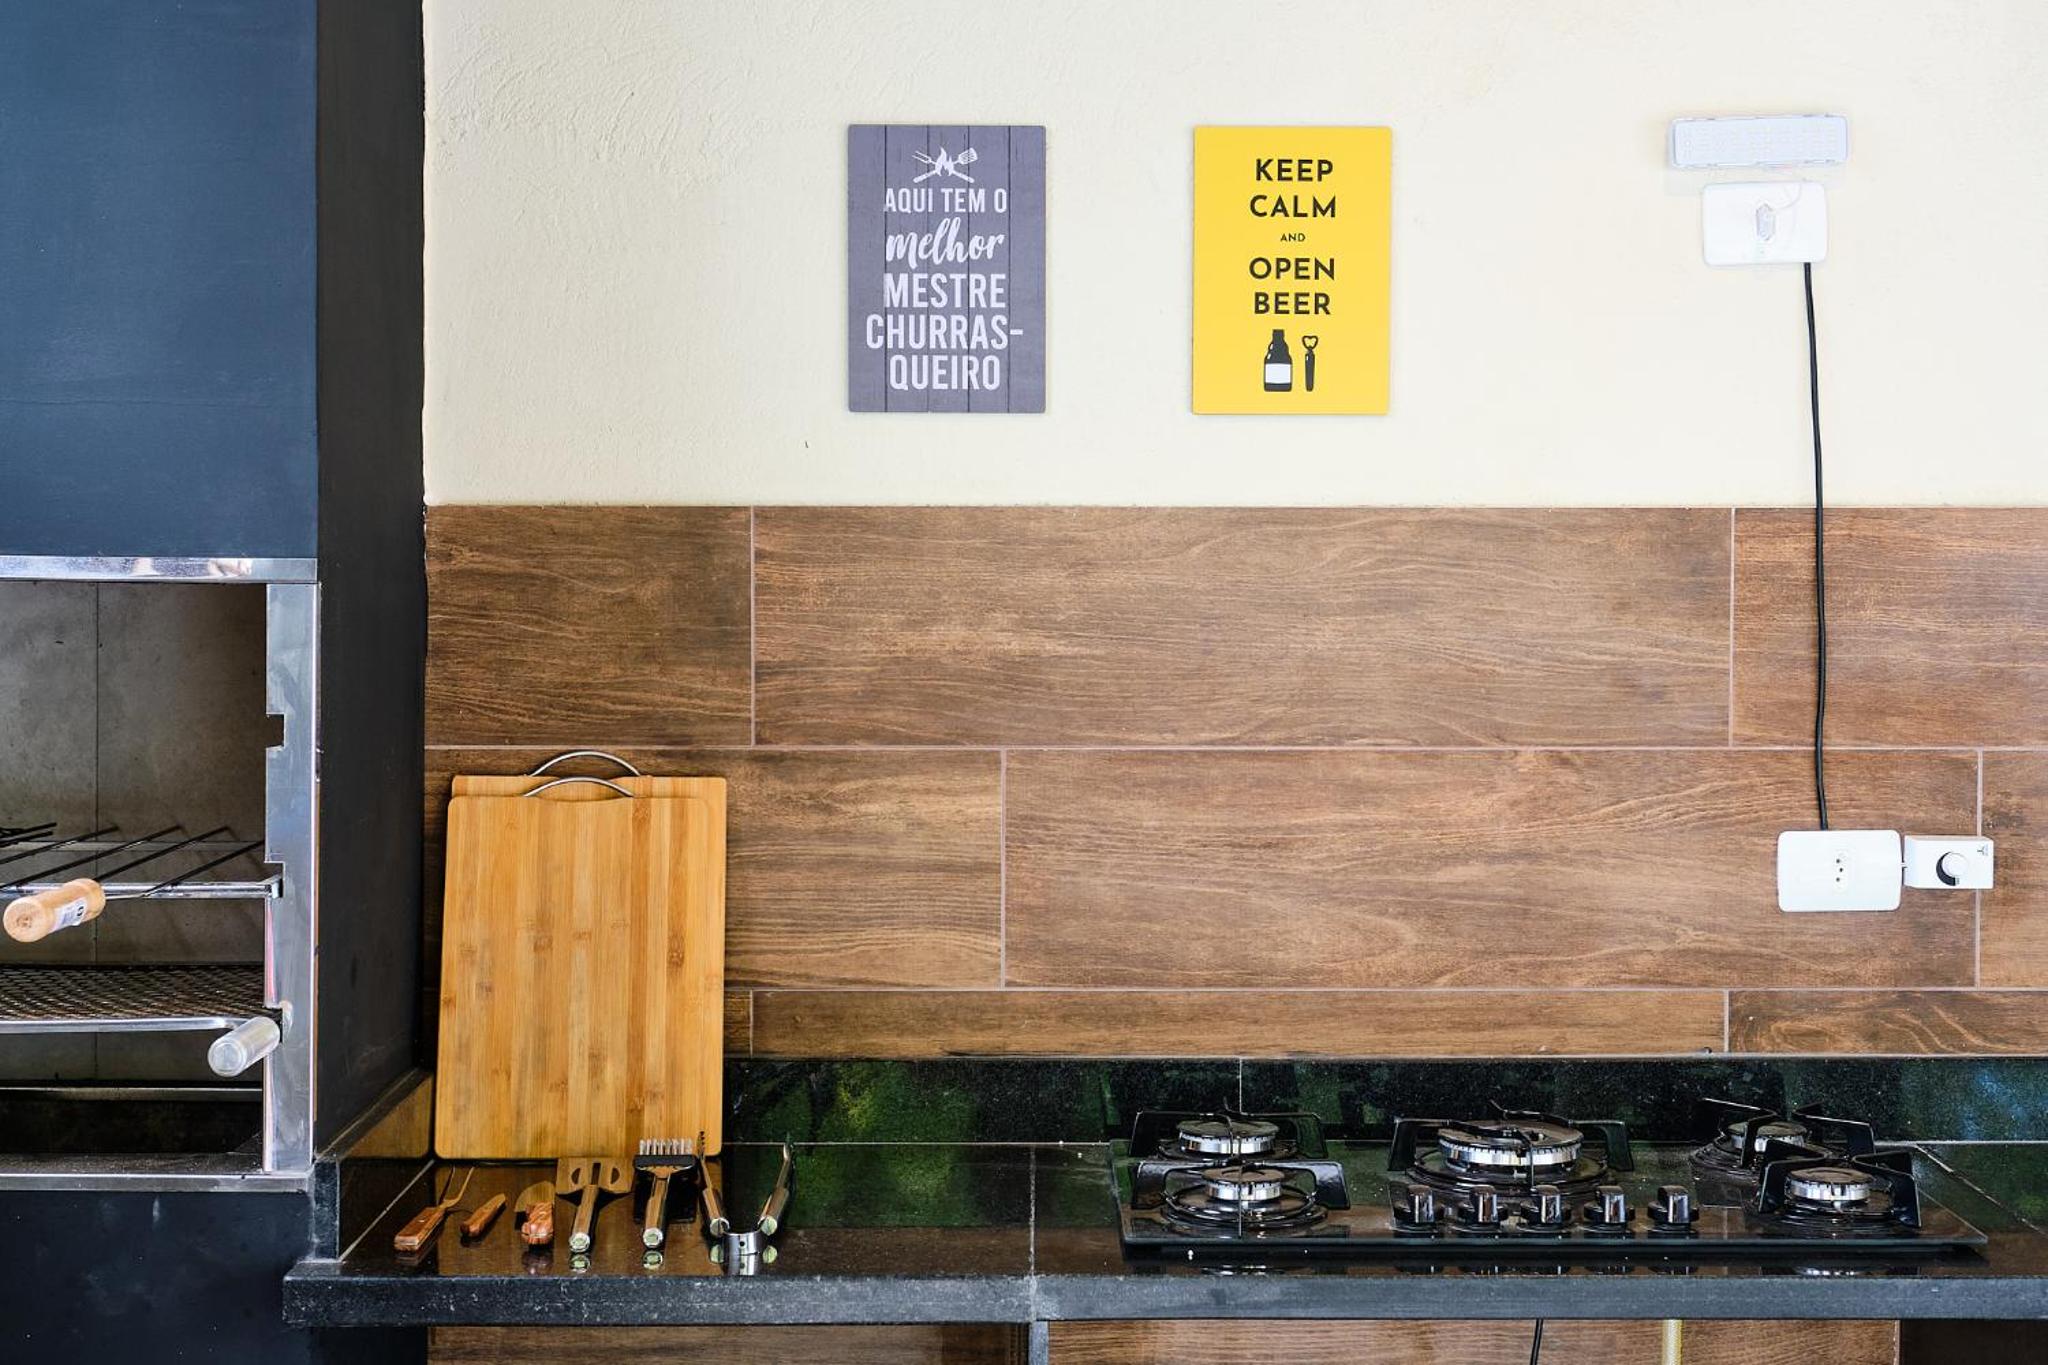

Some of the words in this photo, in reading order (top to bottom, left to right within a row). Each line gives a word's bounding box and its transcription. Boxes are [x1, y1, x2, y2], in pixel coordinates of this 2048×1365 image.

[1256, 158, 1334, 182] KEEP
[884, 188, 933, 213] AQUI
[941, 188, 985, 212] TEM
[994, 188, 1007, 213] O
[1250, 195, 1336, 218] CALM
[885, 217, 1004, 269] melhor
[1280, 232, 1306, 242] AND
[1249, 257, 1334, 280] OPEN
[883, 273, 1006, 308] MESTRE
[1254, 292, 1331, 315] BEER
[866, 314, 1023, 349] CHURRAS-
[890, 355, 1000, 390] QUEIRO
